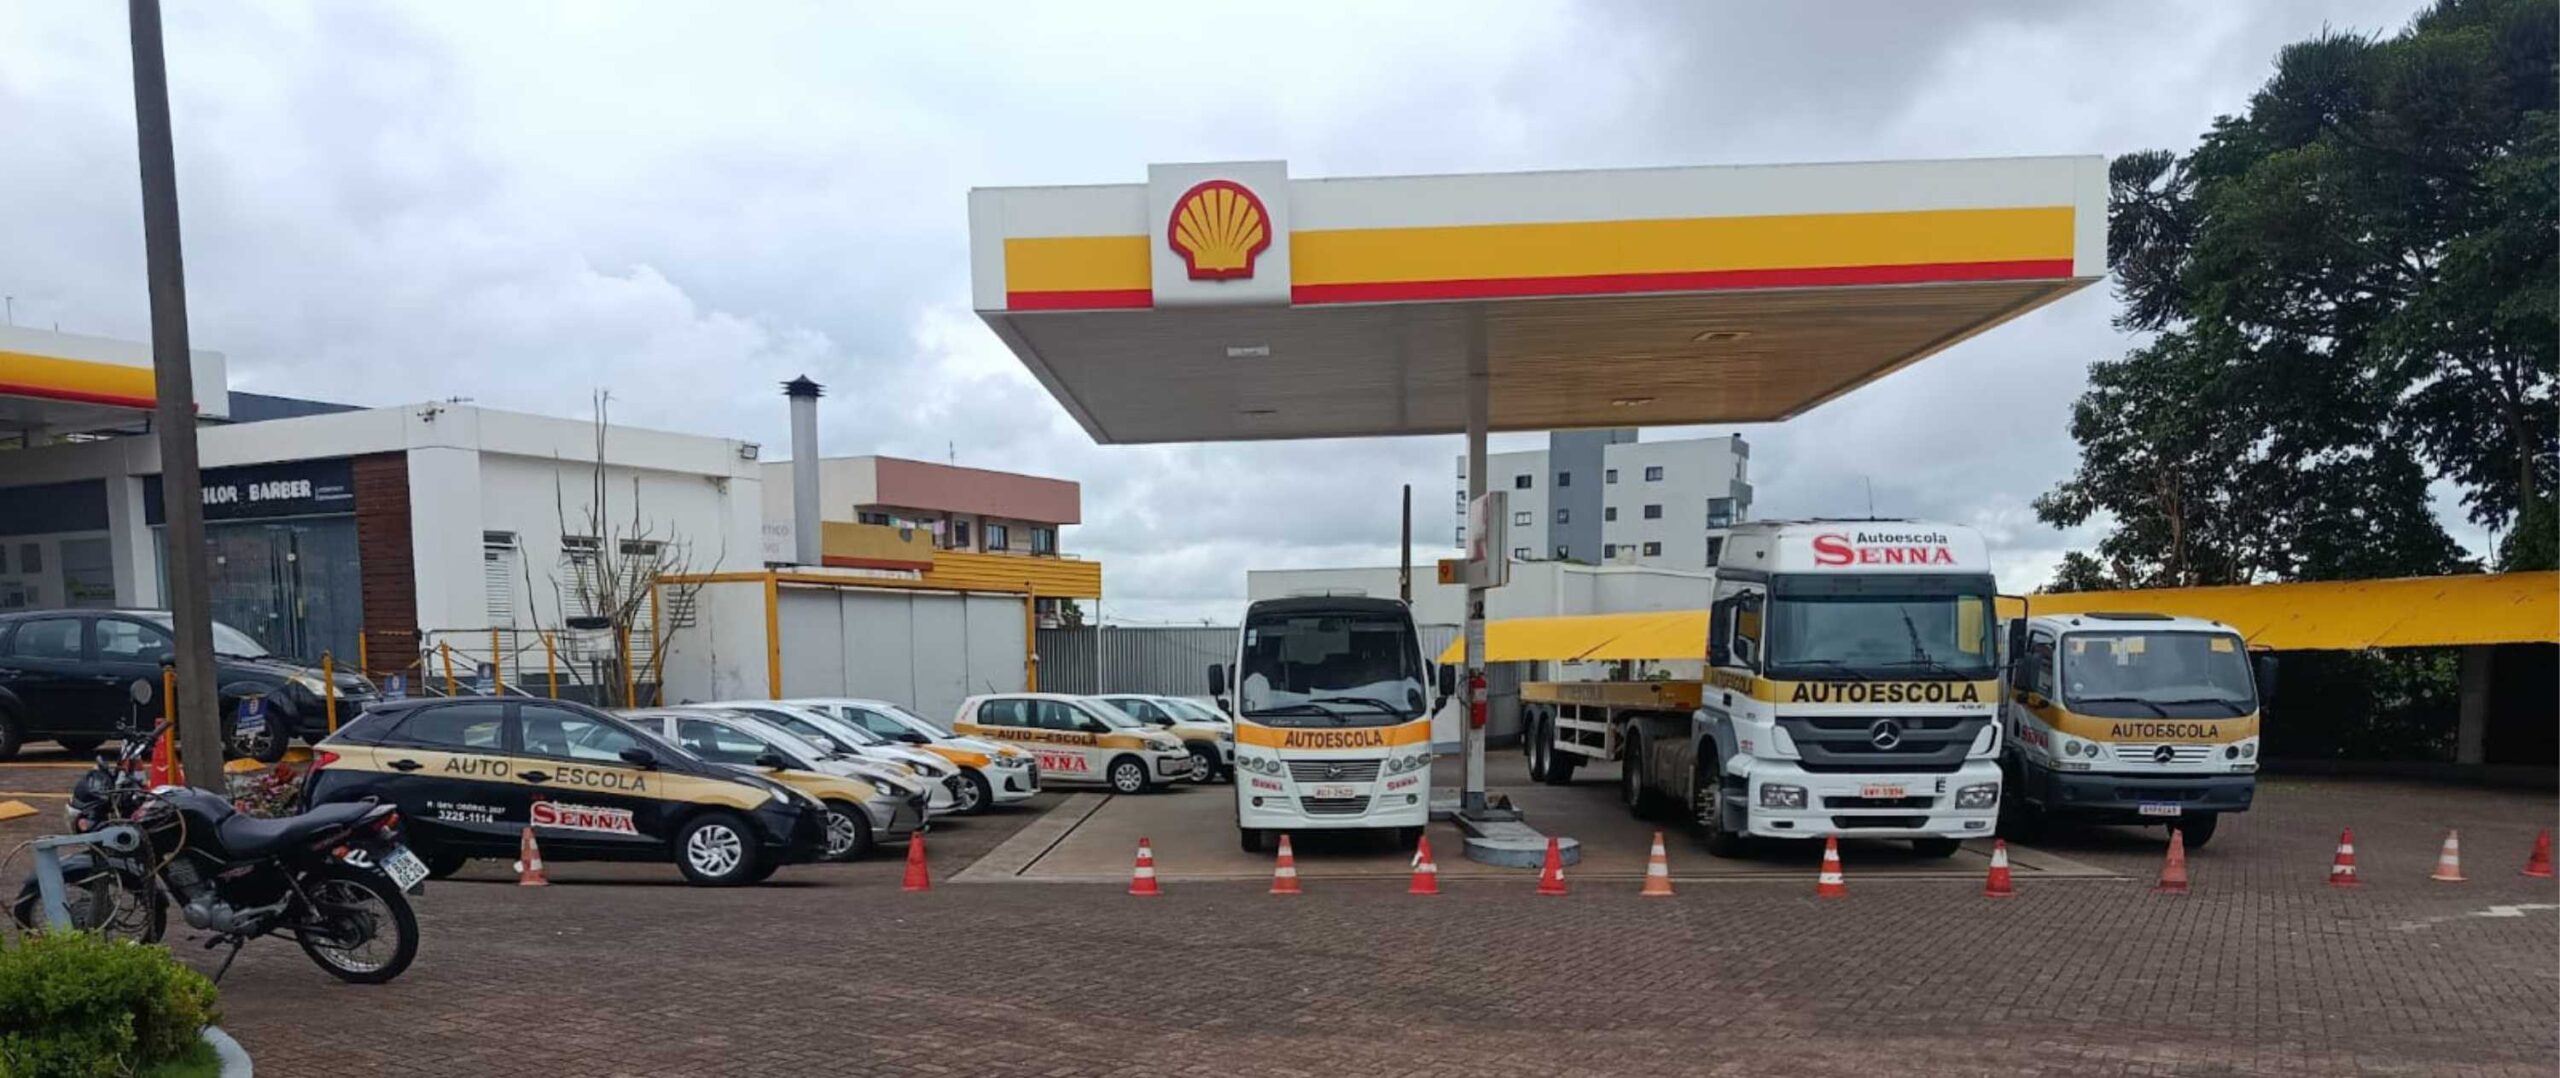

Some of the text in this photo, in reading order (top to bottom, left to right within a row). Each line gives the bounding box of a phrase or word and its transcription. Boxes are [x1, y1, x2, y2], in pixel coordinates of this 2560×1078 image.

[202, 479, 311, 504] ILOR BARBER
[1857, 532, 1948, 544] Autoescola
[1813, 533, 1957, 567] SENNA
[1791, 682, 1979, 703] AUTOESCOLA
[998, 730, 1098, 746] AUTO ESCOLA
[1285, 730, 1383, 748] AUTOESCOLA
[2111, 723, 2218, 738] AUTOESCOLA
[1040, 756, 1090, 771] NNA
[444, 757, 646, 791] AUTO ESCOLA
[438, 810, 493, 824] 3225-1114
[532, 802, 637, 833] SENNA
